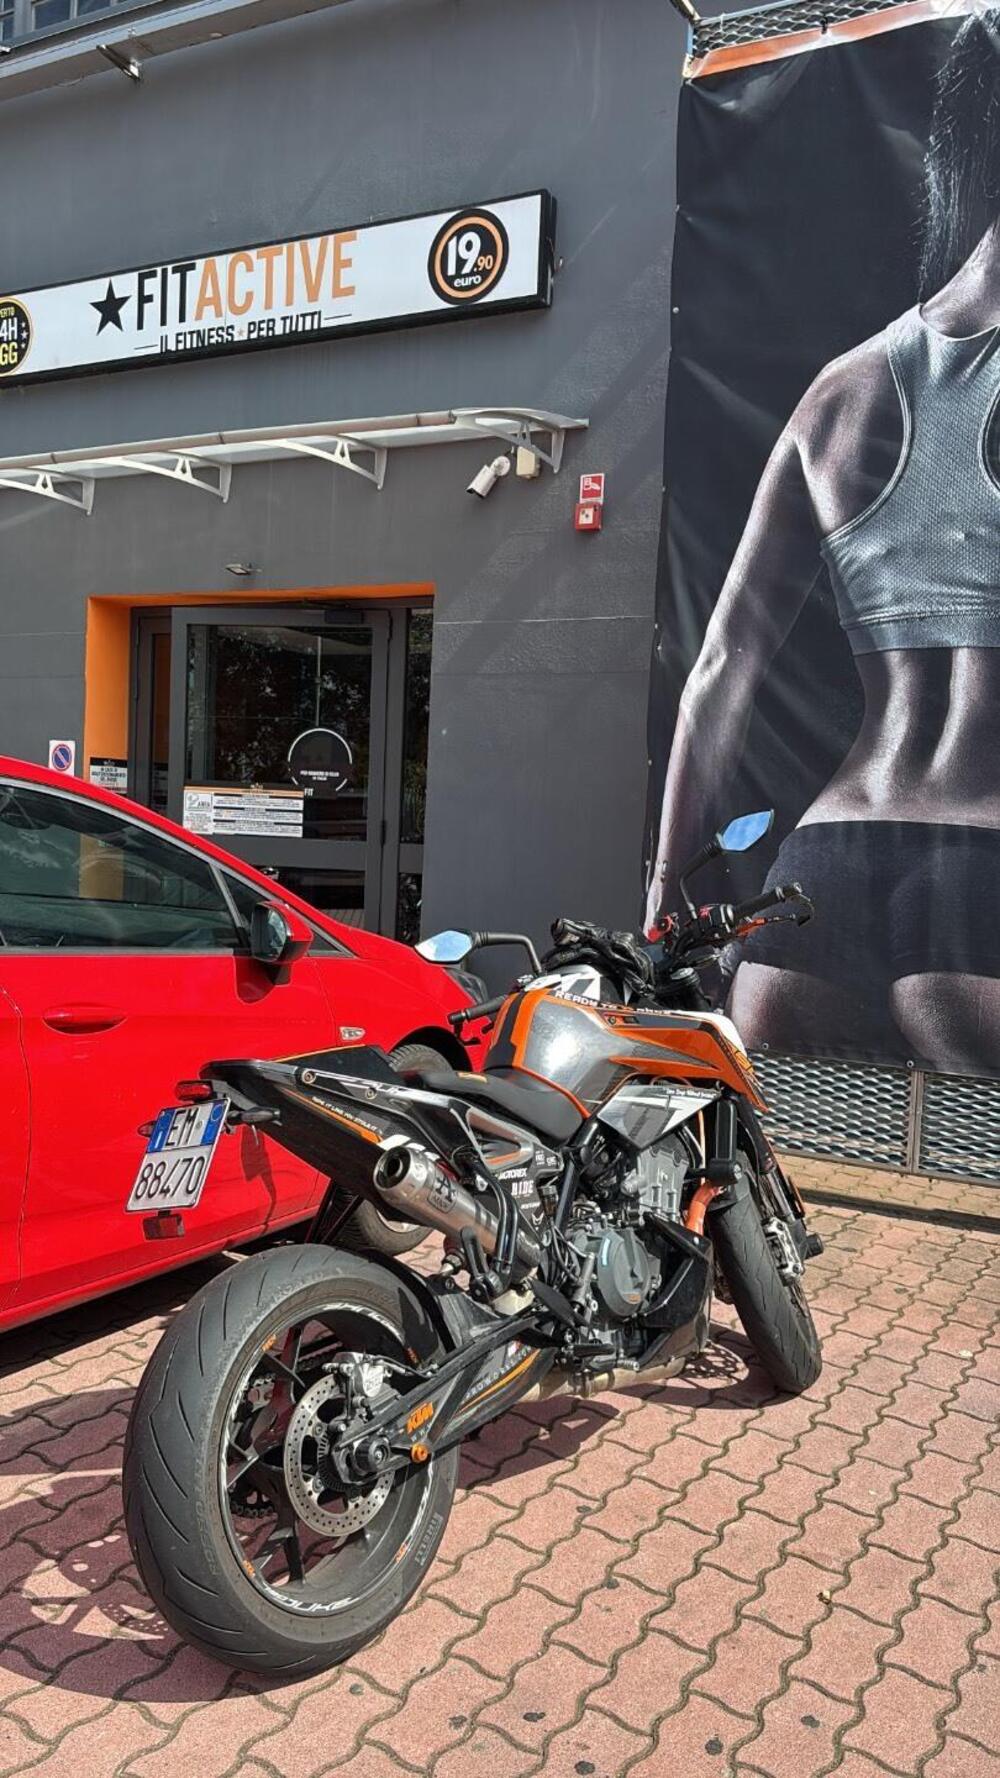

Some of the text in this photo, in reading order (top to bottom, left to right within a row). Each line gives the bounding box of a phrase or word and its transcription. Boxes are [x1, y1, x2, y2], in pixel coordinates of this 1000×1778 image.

[136, 231, 357, 331] FITACTIVE
[453, 275, 482, 287] euro
[175, 325, 235, 352] FITNESS
[247, 314, 277, 340] PER
[281, 310, 322, 335] TUTTI
[165, 1106, 200, 1147] EM
[135, 1155, 206, 1200] 88470
